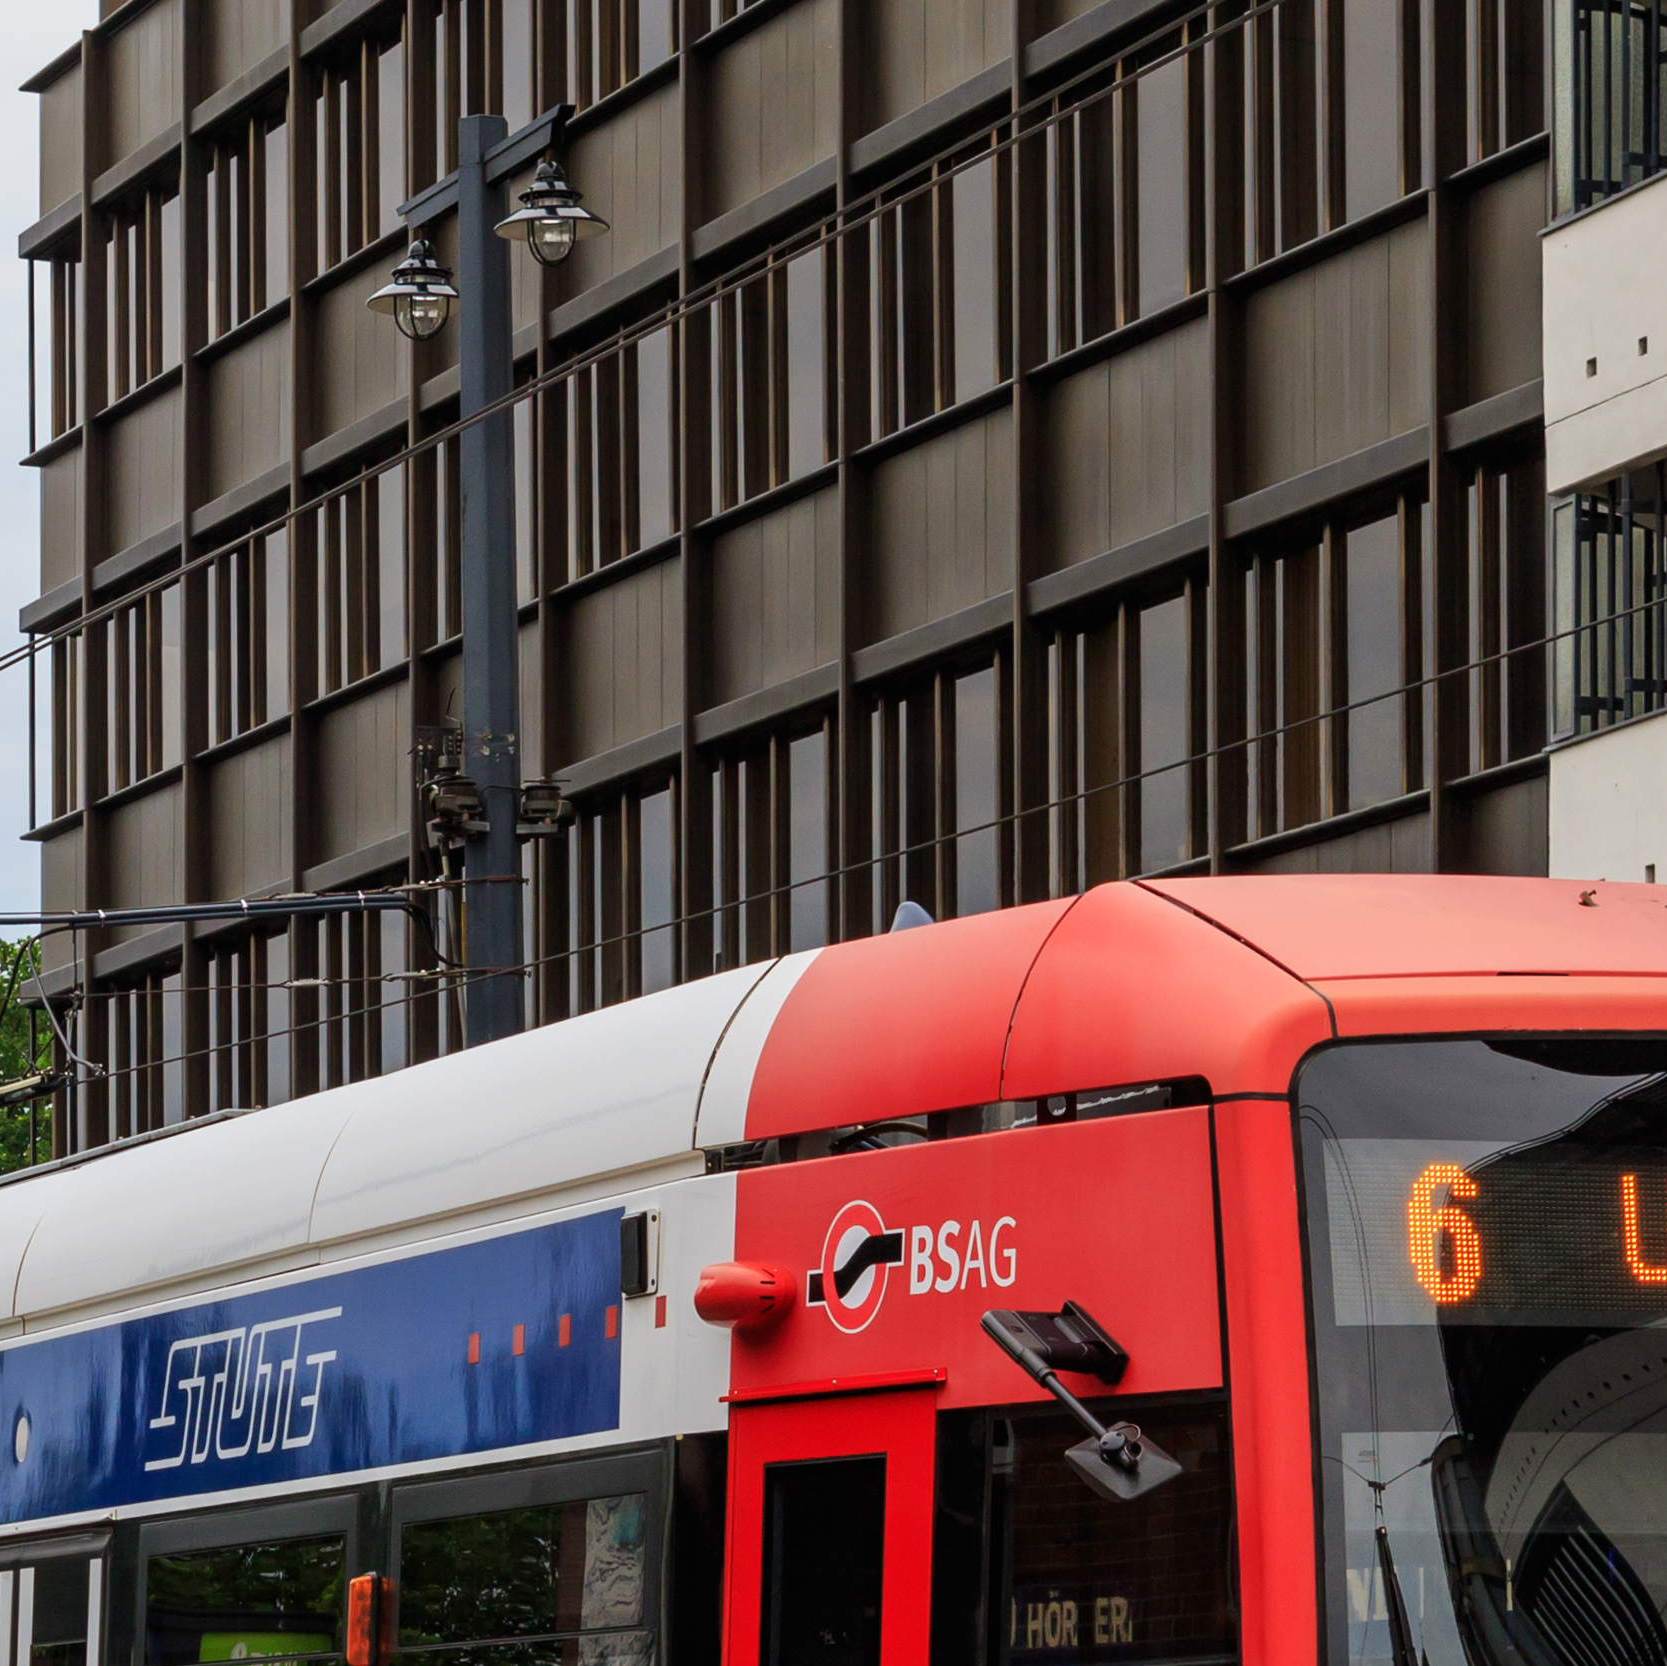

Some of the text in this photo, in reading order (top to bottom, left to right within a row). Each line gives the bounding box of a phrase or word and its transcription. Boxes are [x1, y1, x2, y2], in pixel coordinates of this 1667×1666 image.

[910, 1215, 1017, 1295] BSAG
[1408, 1164, 1482, 1303] 6
[144, 1306, 343, 1472] STUTE
